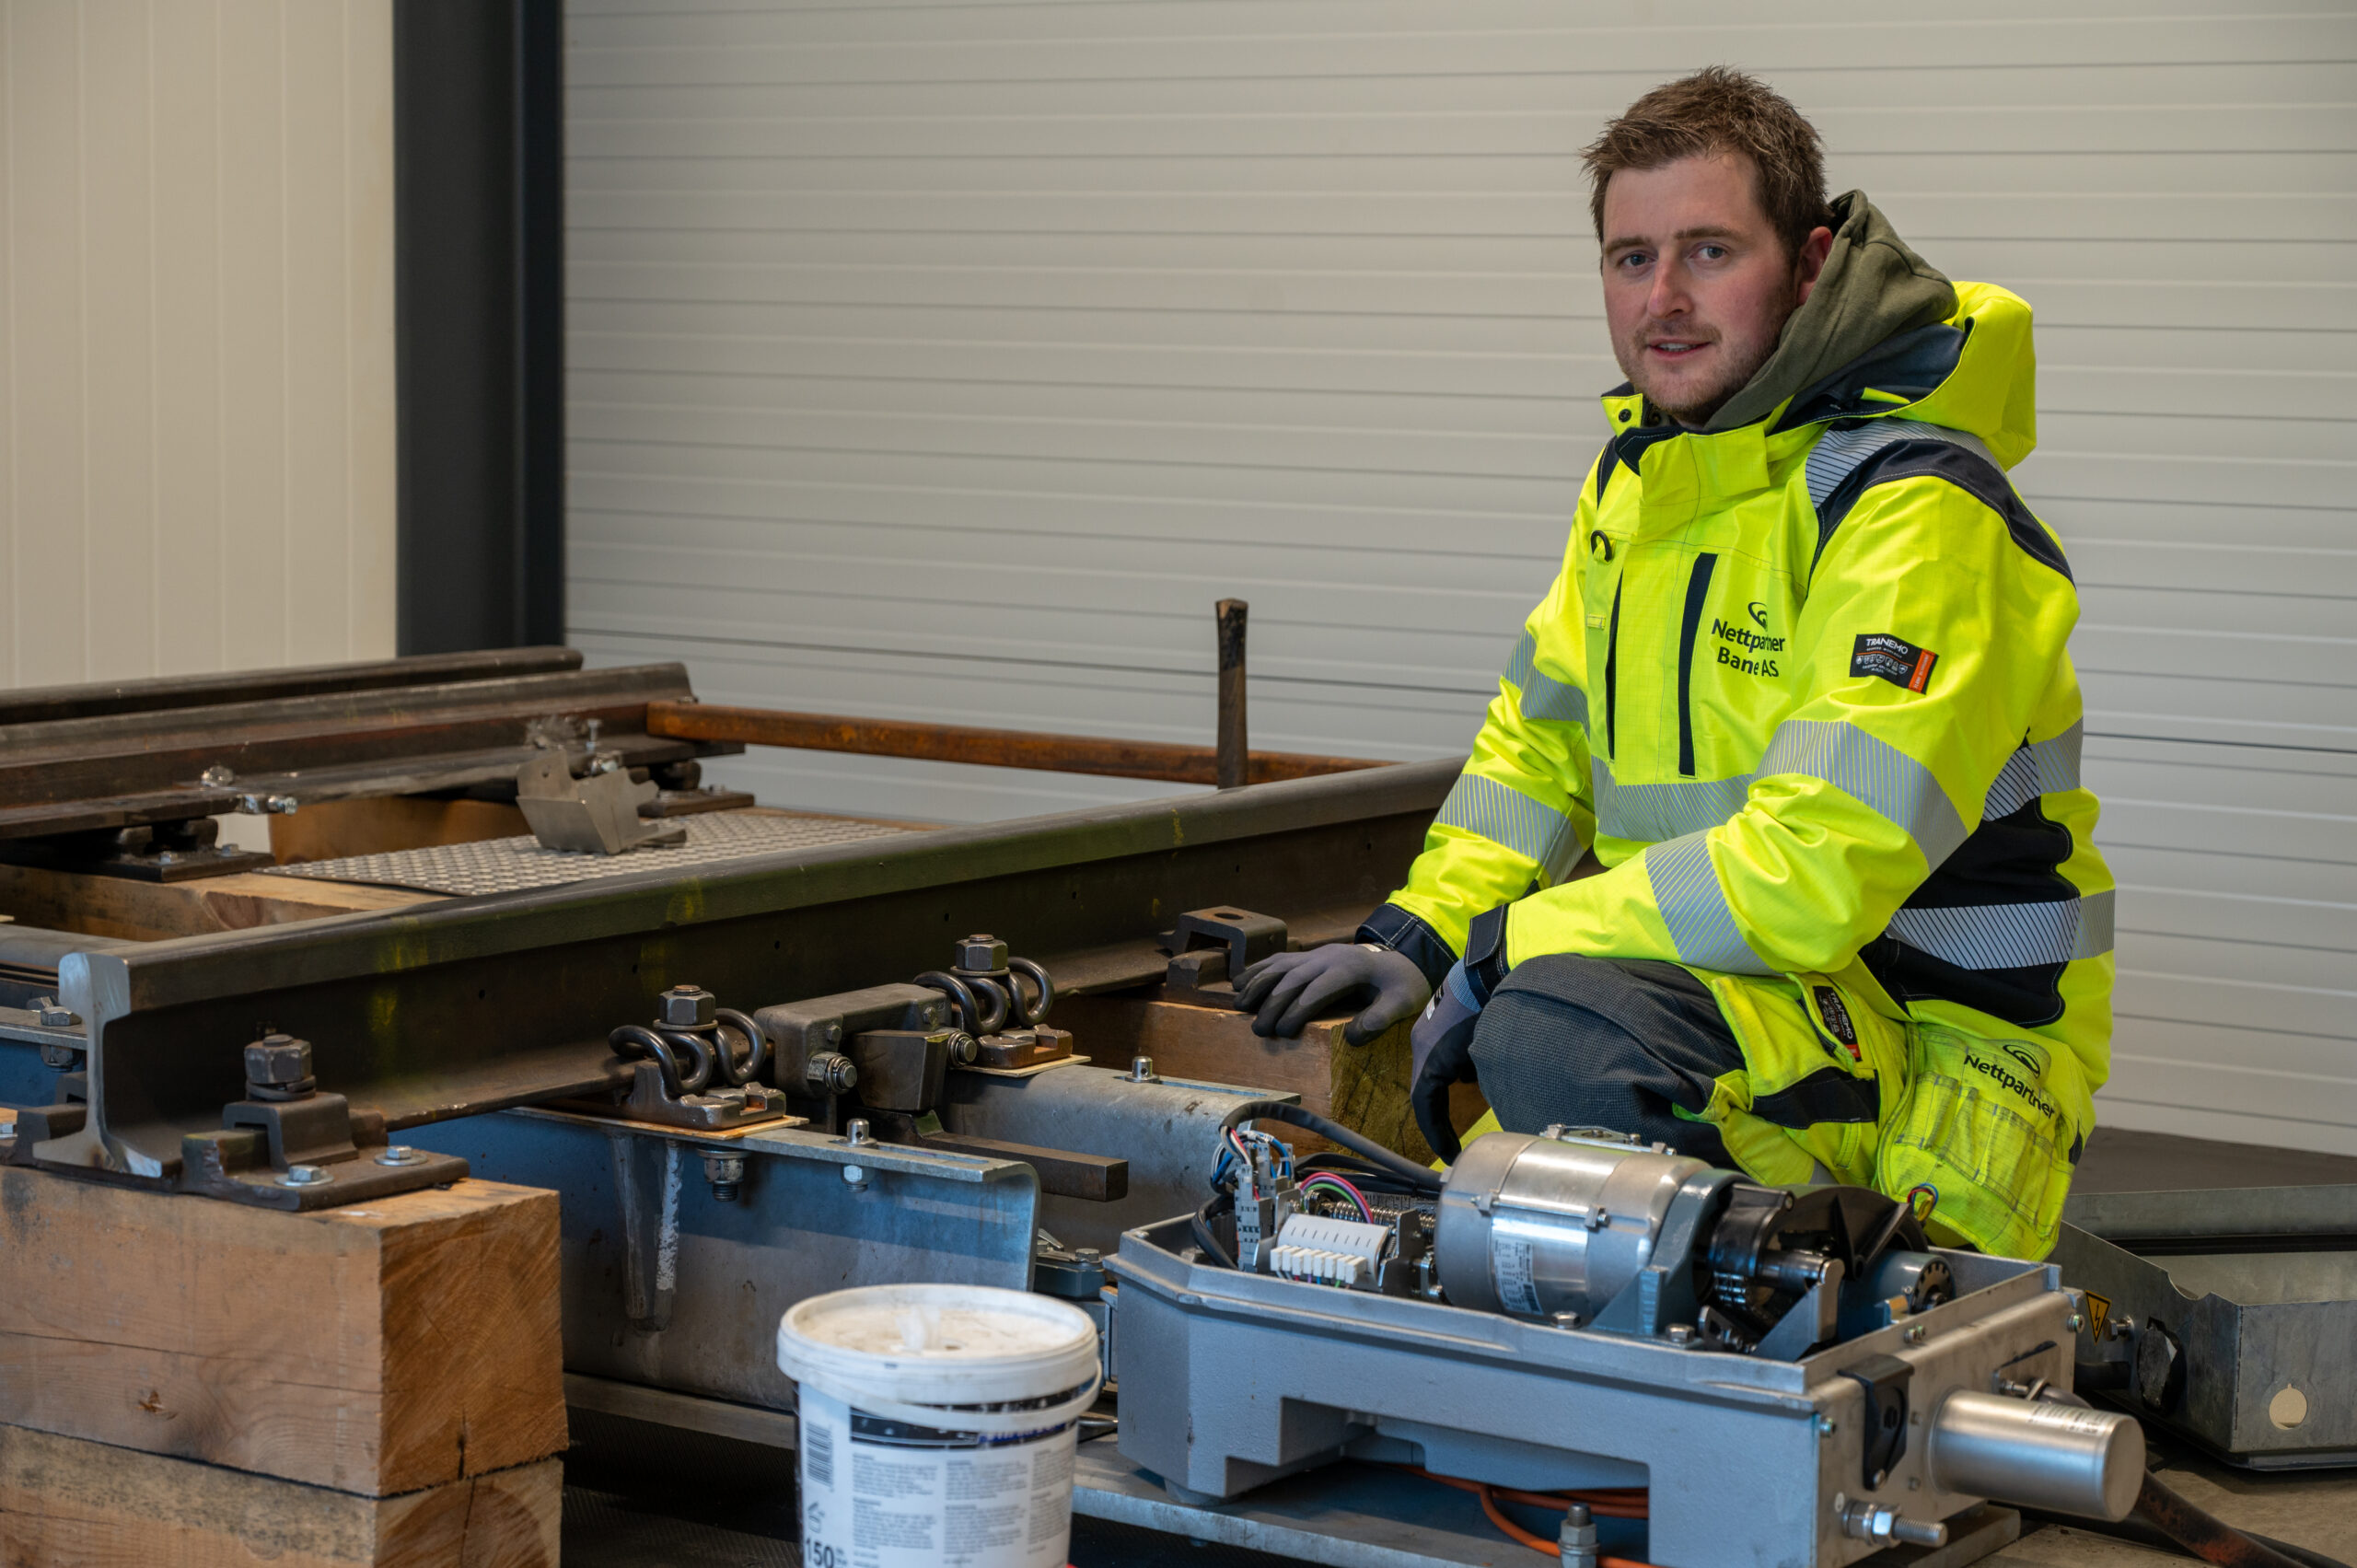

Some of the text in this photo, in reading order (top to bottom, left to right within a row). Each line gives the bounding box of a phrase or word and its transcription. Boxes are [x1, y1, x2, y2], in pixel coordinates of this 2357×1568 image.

[1712, 618, 1785, 653] Nettpaner
[1865, 637, 1909, 655] TRANEMO
[1717, 645, 1780, 678] Bane AS
[1830, 992, 1853, 1040] TRANEMO
[1964, 1054, 2055, 1119] Nettpartner
